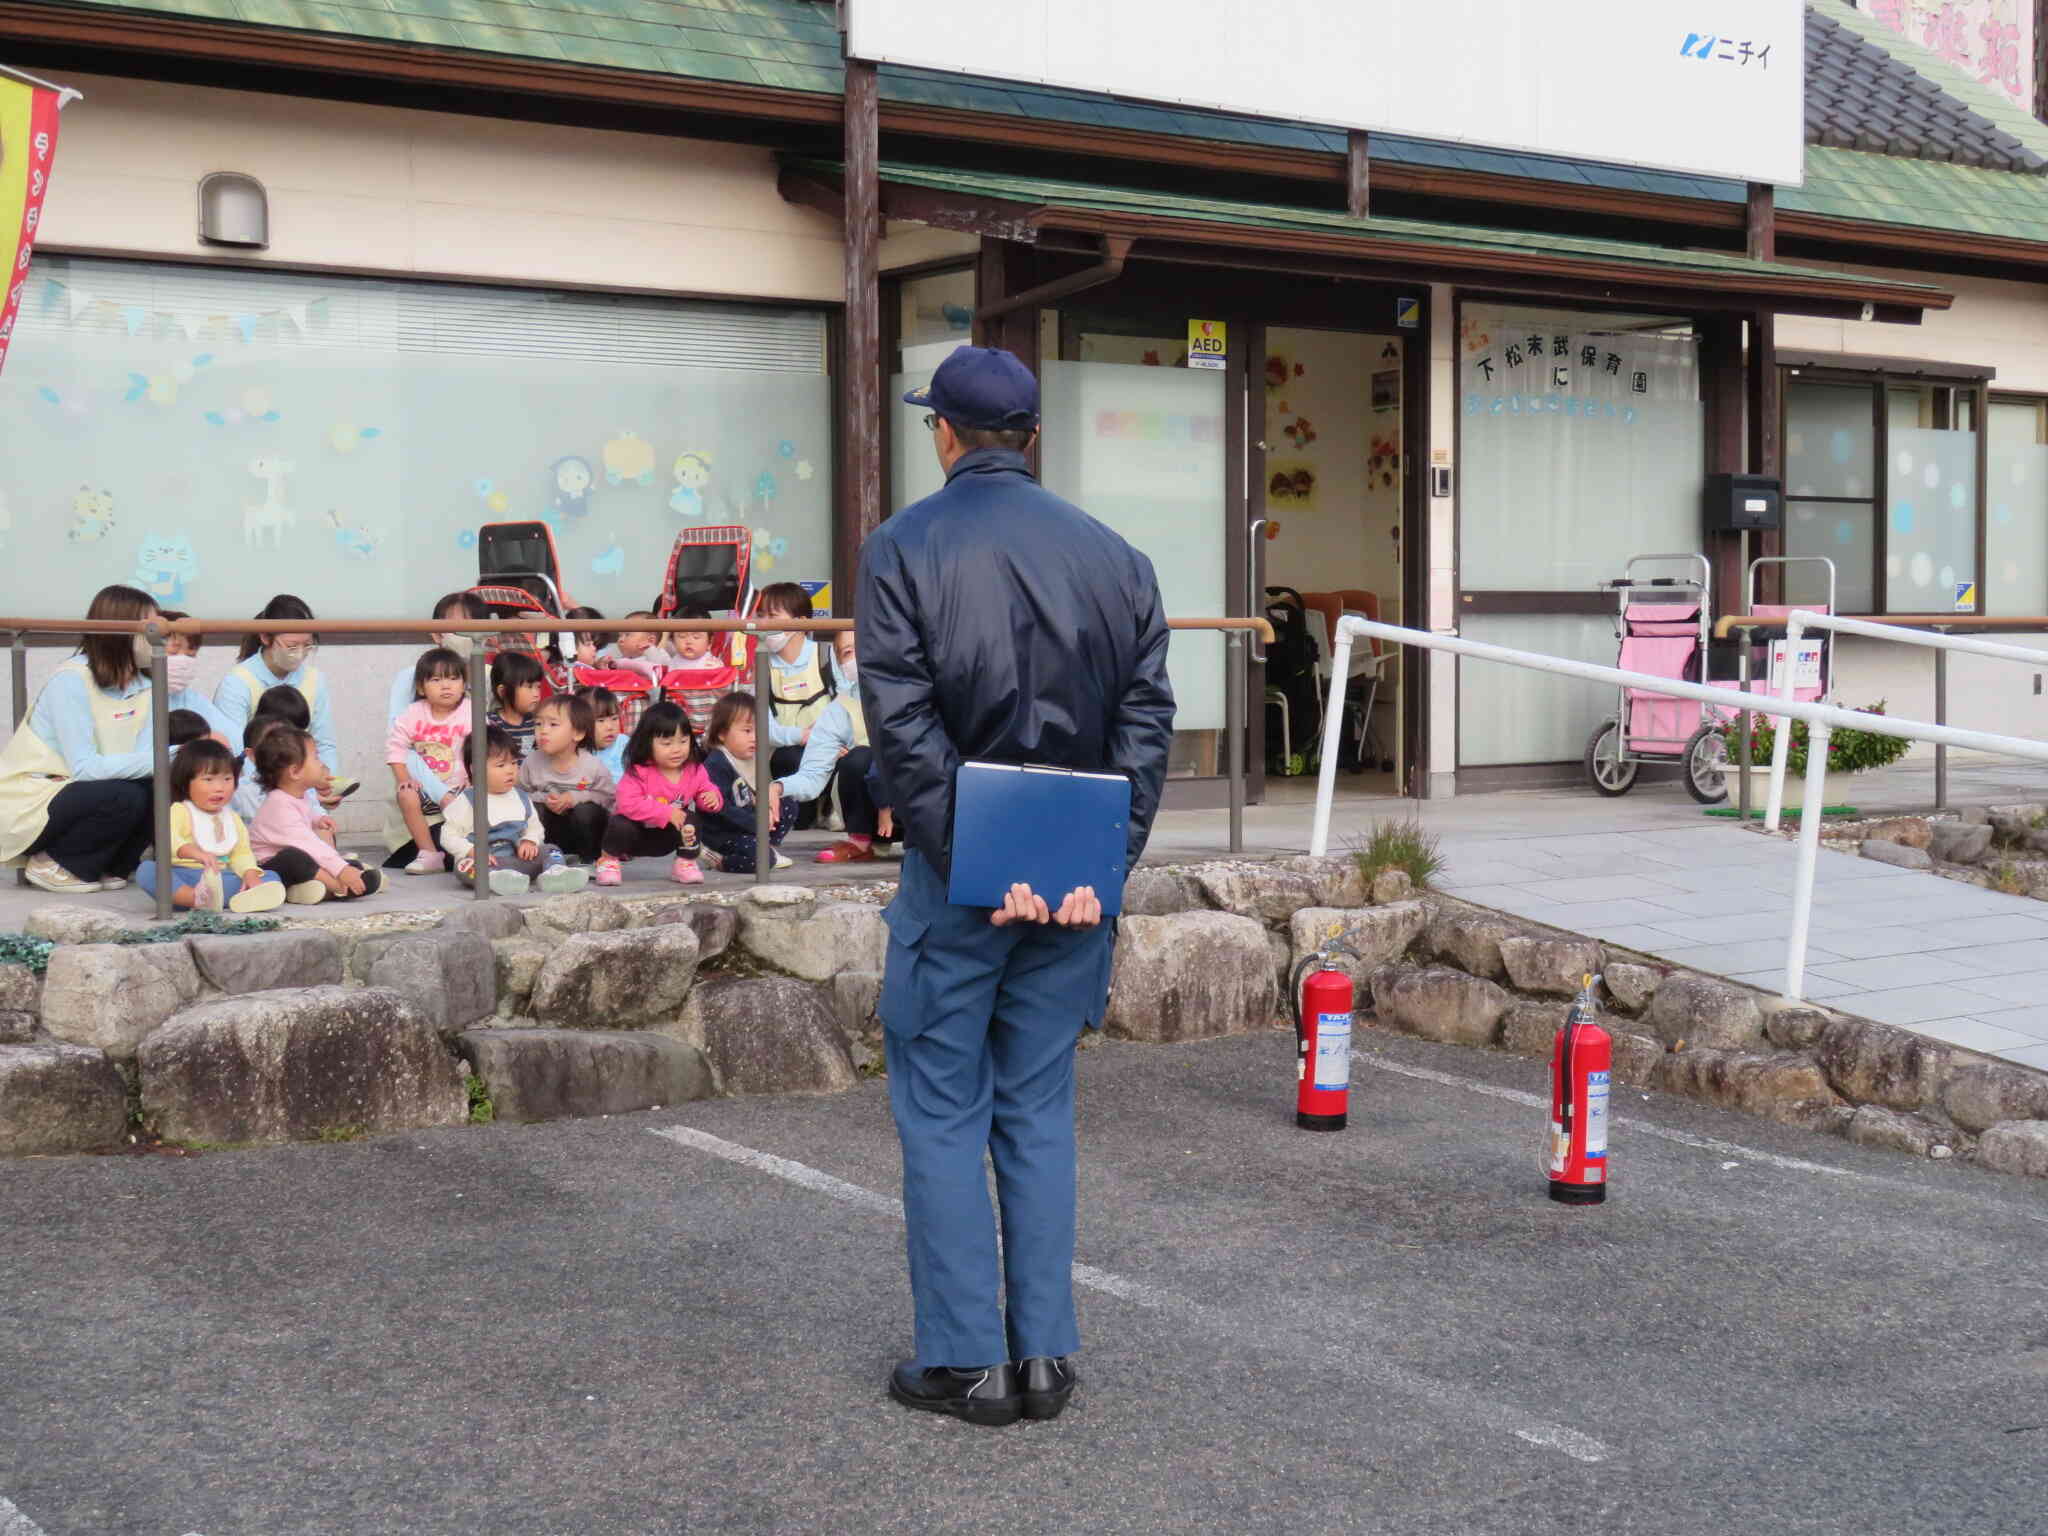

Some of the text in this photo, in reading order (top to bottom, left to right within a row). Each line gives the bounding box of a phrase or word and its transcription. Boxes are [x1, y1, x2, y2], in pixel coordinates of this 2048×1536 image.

[1718, 39, 1771, 70] ニチイ
[1192, 338, 1223, 352] AED
[1477, 334, 1647, 393] 下松末武保育園
